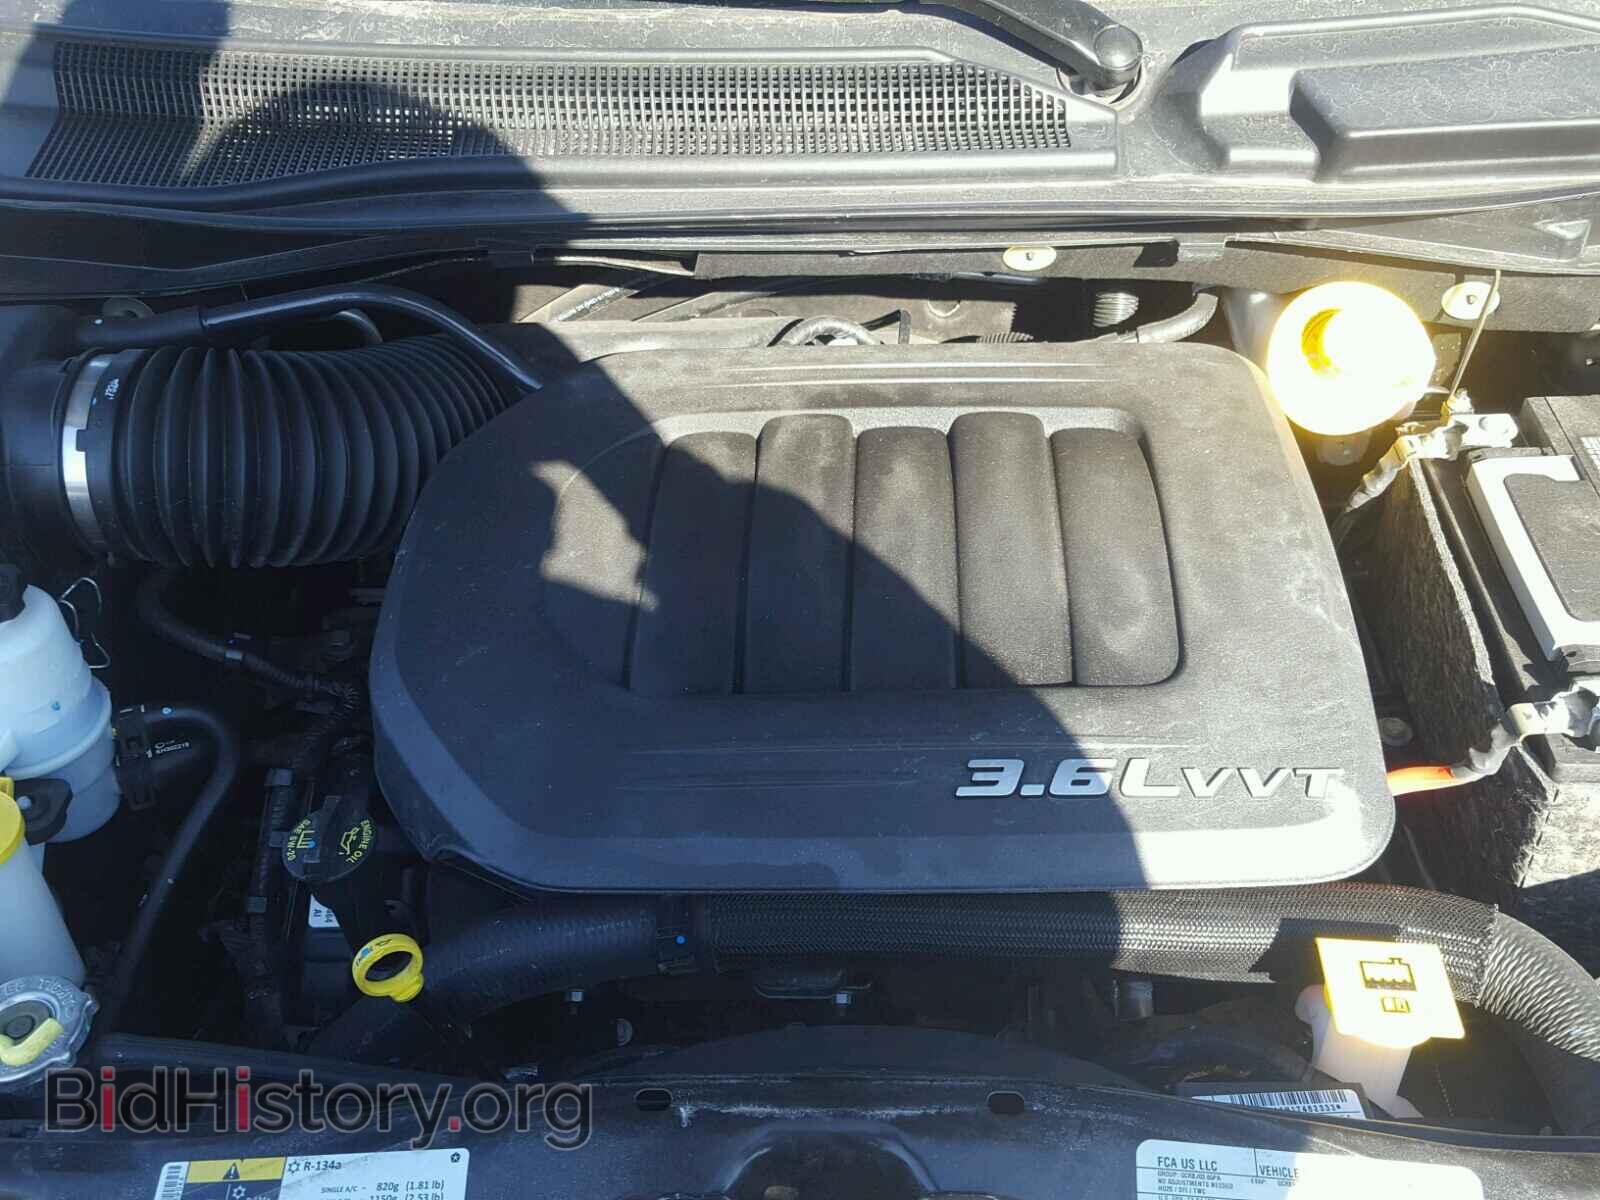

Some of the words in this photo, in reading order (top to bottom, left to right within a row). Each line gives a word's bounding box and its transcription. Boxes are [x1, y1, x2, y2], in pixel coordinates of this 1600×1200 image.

[345, 850, 363, 863] OIL
[303, 1159, 342, 1171] R-134a
[1157, 1156, 1178, 1168] FCA
[1180, 1158, 1196, 1170] US
[1198, 1160, 1218, 1172] LLC
[344, 1185, 358, 1193] A/C
[376, 1182, 399, 1193] 820g
[406, 1180, 428, 1192] (1.81
[431, 1179, 445, 1191] lb)
